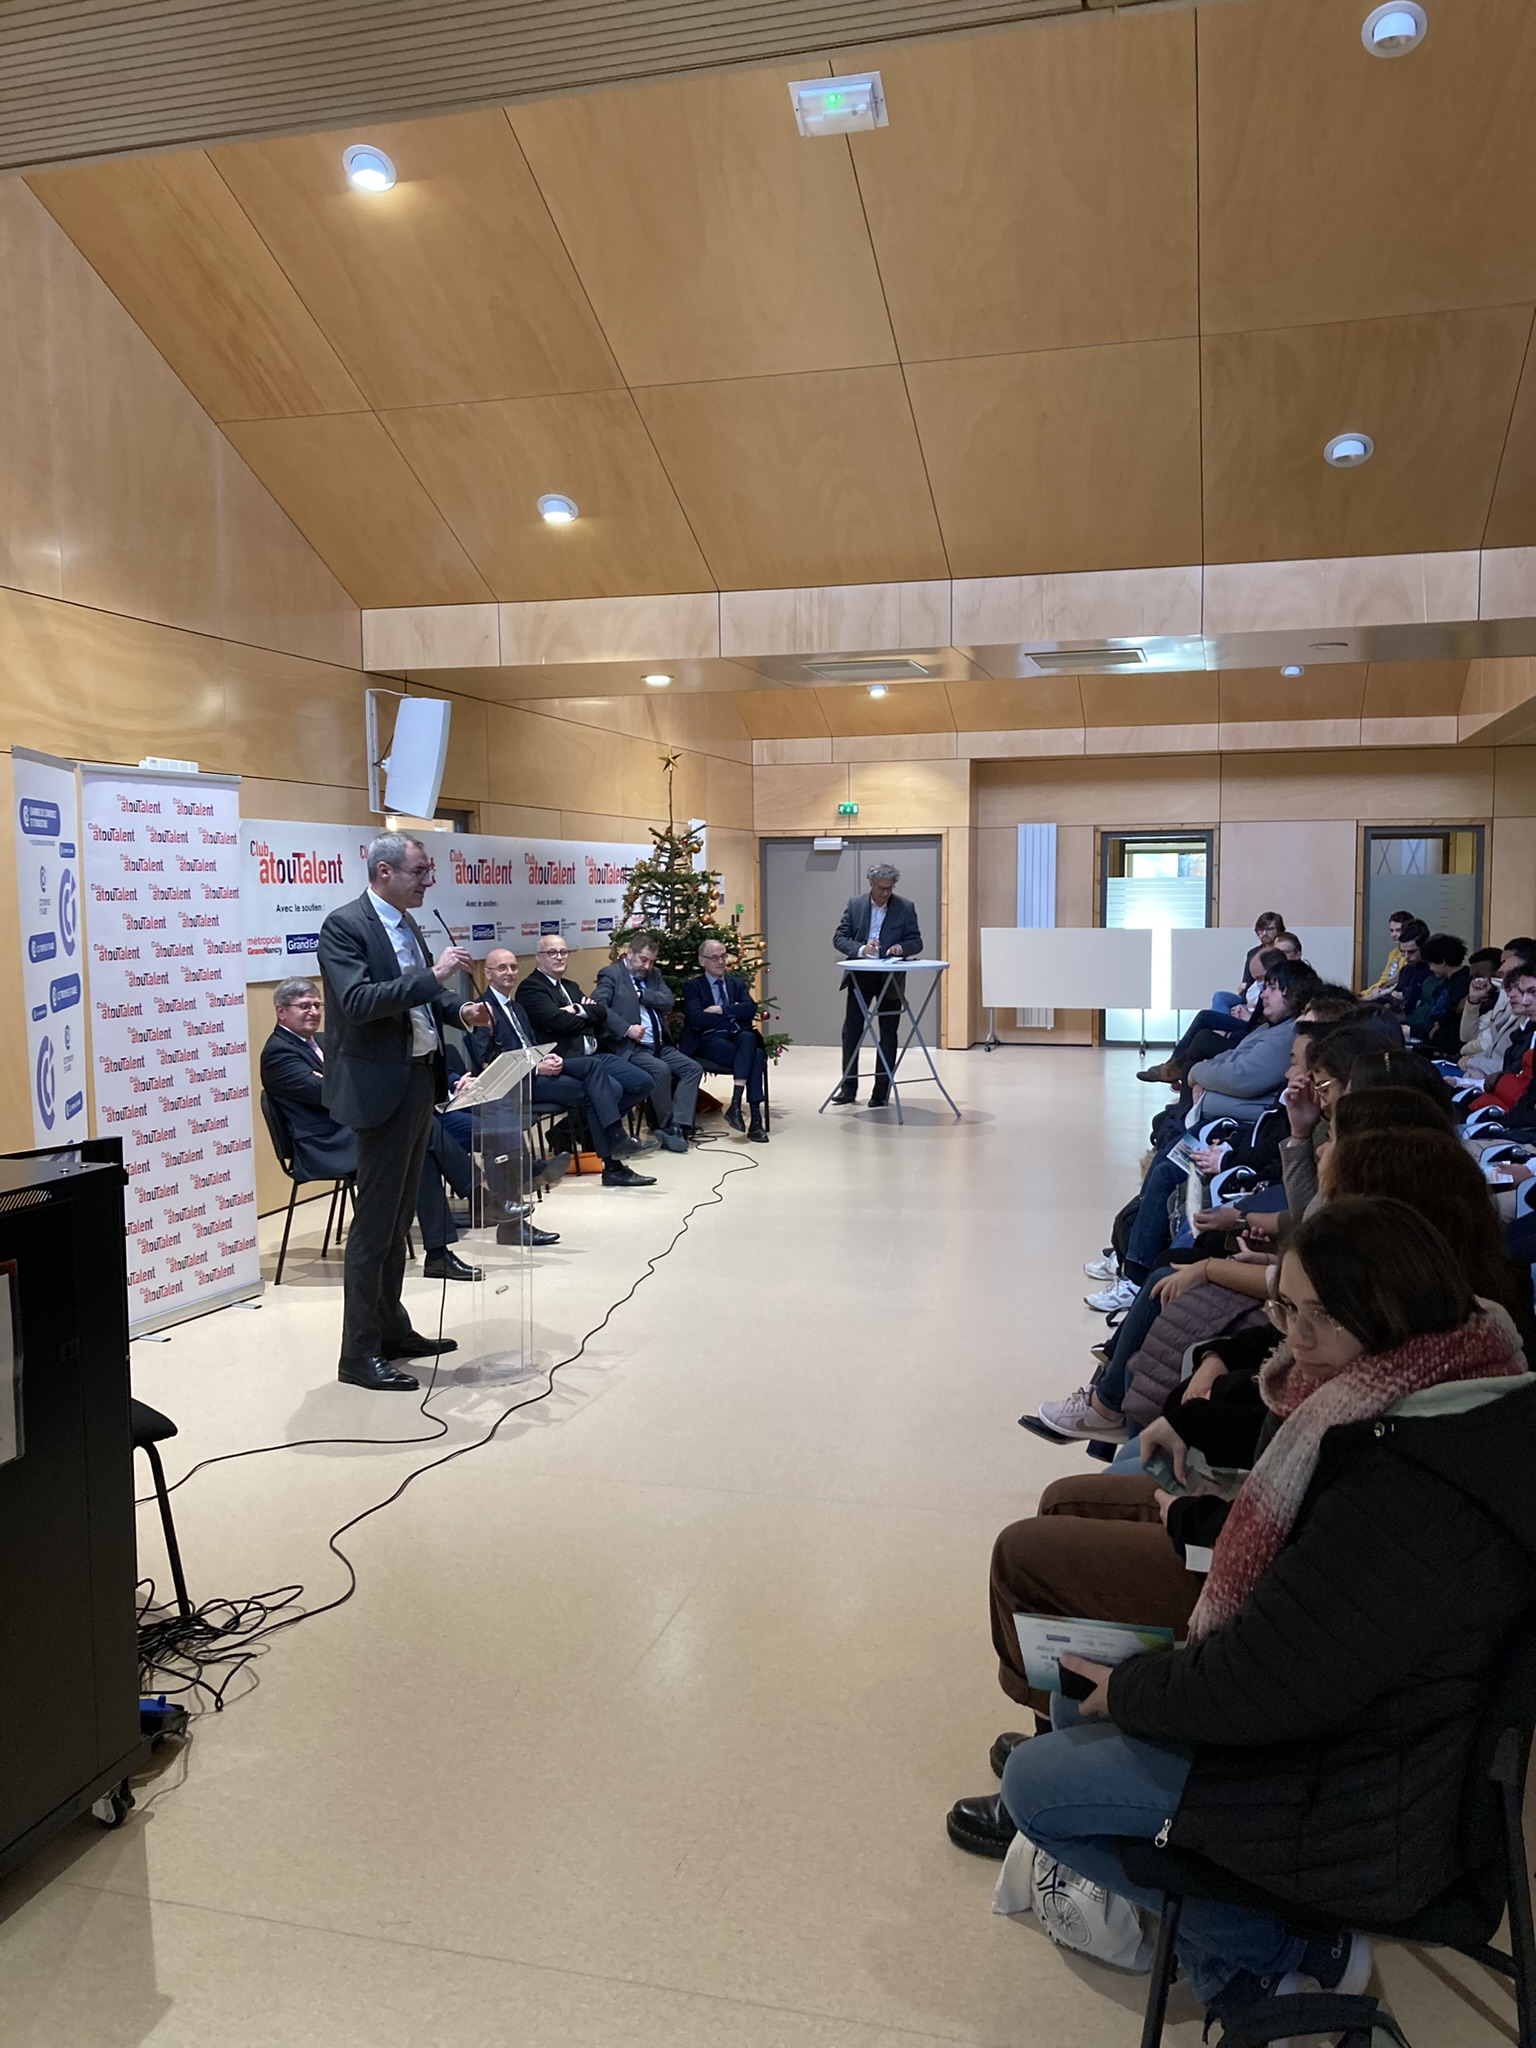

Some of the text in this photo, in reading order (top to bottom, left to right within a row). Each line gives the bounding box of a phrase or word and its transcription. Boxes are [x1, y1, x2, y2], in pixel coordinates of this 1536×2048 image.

[121, 800, 161, 814] atouTalent
[177, 803, 214, 817] atouTalent
[93, 827, 135, 842] atouTalent
[150, 830, 189, 844] atouTalent
[202, 831, 238, 845] atouTalent
[250, 840, 269, 856] Club
[450, 849, 463, 862] Club
[124, 858, 164, 872] atouTalent
[179, 859, 217, 872] atouTalent
[524, 853, 536, 864] Club
[259, 850, 344, 884] atouTalent
[455, 858, 512, 884] atouTalent
[528, 860, 576, 884] atouTalent
[96, 887, 138, 901] atouTalent
[152, 887, 191, 901] atouTalent
[205, 886, 239, 900] atouTalent
[276, 904, 293, 912] Avec
[294, 904, 301, 912] le
[302, 903, 322, 912] soutien
[126, 916, 167, 930] atouTalent
[182, 915, 219, 928] atouTalent
[207, 941, 242, 954] atouTalent
[247, 935, 282, 945] métropole
[287, 938, 309, 950] Grand
[99, 946, 140, 961] atouTalent
[155, 943, 194, 958] atouTalent
[128, 971, 169, 987] atouTalent
[185, 967, 222, 982] atouTalent
[158, 998, 197, 1013] atouTalent
[209, 993, 244, 1008] atouTalent
[102, 1003, 142, 1019] atouTalent
[131, 1027, 172, 1044] atouTalent
[187, 1020, 224, 1037] atouTalent
[160, 1048, 199, 1065] atouTalent
[212, 1041, 247, 1057] atouTalent
[104, 1055, 145, 1073] atouTalent
[189, 1066, 226, 1084] atouTalent
[134, 1075, 174, 1093] atouTalent
[213, 1085, 249, 1103] atouTalent
[162, 1094, 201, 1113] atouTalent
[106, 1103, 147, 1123] atouTalent
[191, 1116, 228, 1134] atouTalent
[136, 1127, 176, 1146] atouTalent
[216, 1137, 252, 1156] atouTalent
[165, 1148, 204, 1168] atouTalent
[125, 1160, 151, 1176] Talent
[194, 1169, 231, 1190] atouTalent
[138, 1182, 179, 1203] atouTalent
[219, 1192, 254, 1211] atouTalent
[167, 1203, 206, 1224] atouTalent
[125, 1217, 153, 1236] uTalent
[196, 1217, 233, 1238] atouTalent
[141, 1232, 181, 1254] atouTalent
[221, 1236, 256, 1257] atouTalent
[170, 1251, 208, 1273] atouTalent
[127, 1267, 155, 1286] uTalent
[198, 1263, 235, 1286] atouTalent
[144, 1280, 183, 1304] atouTalent
